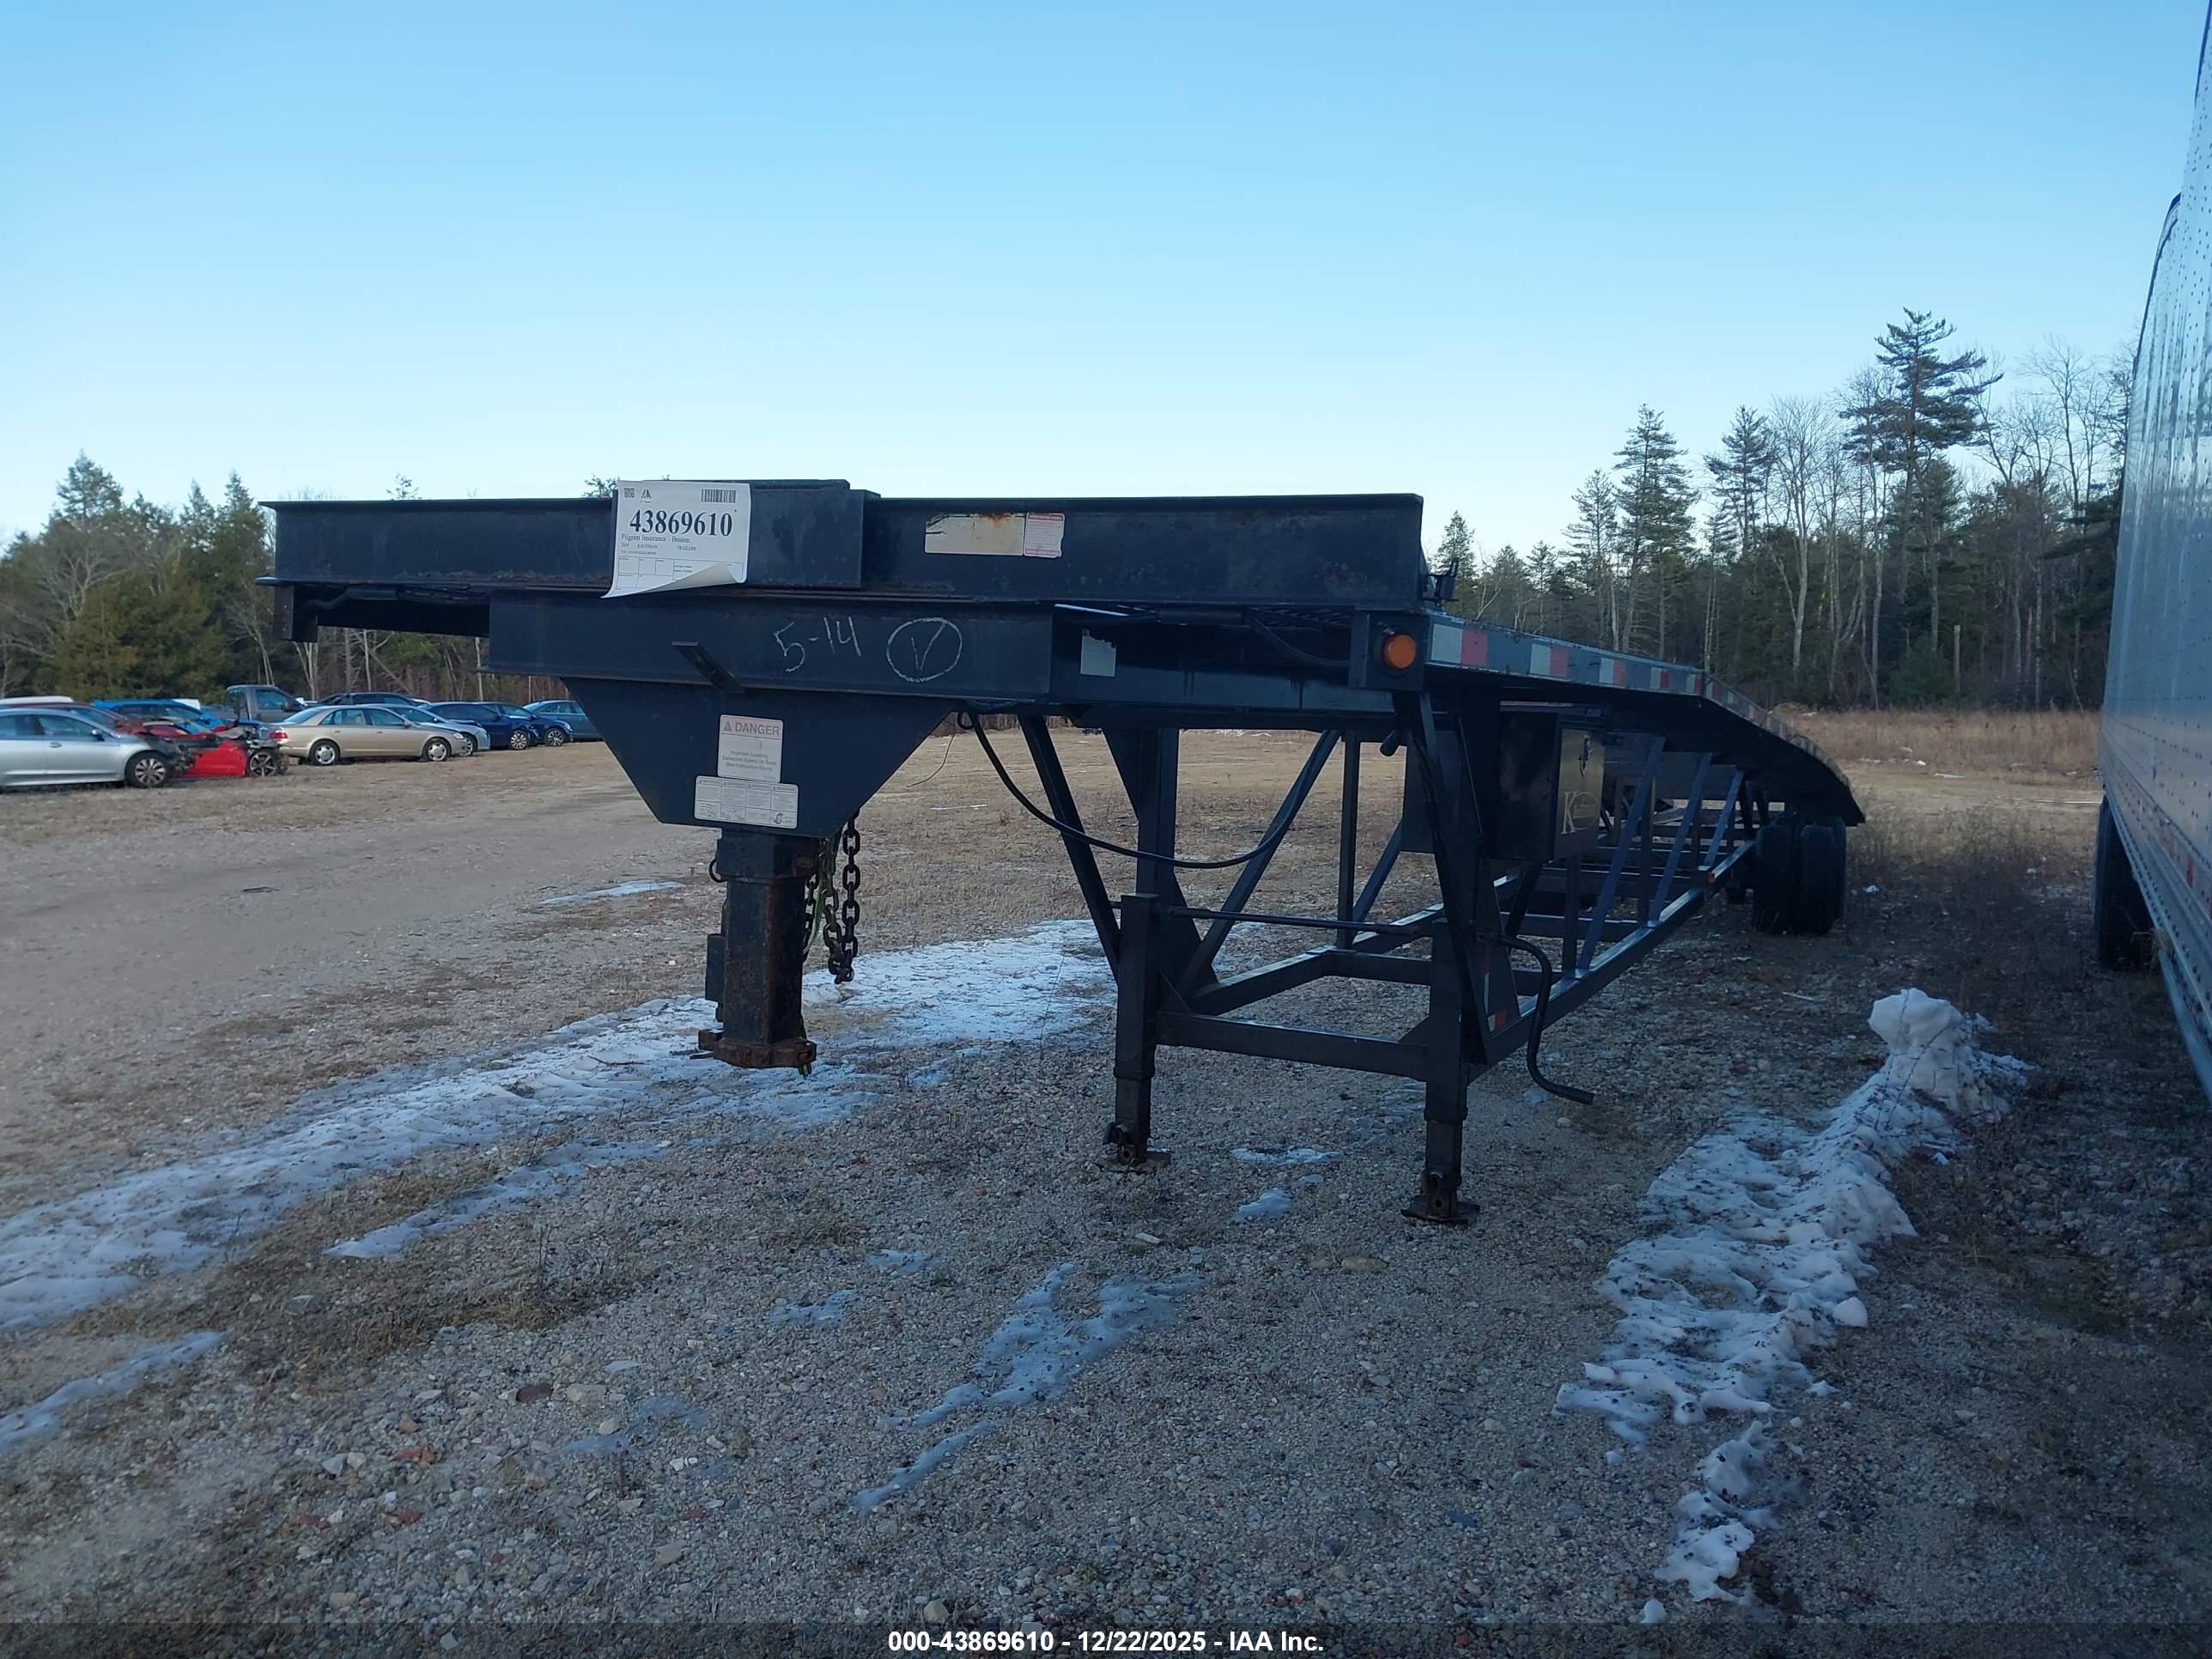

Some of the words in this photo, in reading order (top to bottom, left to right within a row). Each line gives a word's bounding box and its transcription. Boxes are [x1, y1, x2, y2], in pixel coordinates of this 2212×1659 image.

[629, 509, 732, 537] 43869610
[621, 533, 641, 542] Pilgrim
[774, 617, 861, 672] 5-14
[734, 722, 780, 736] DANGER
